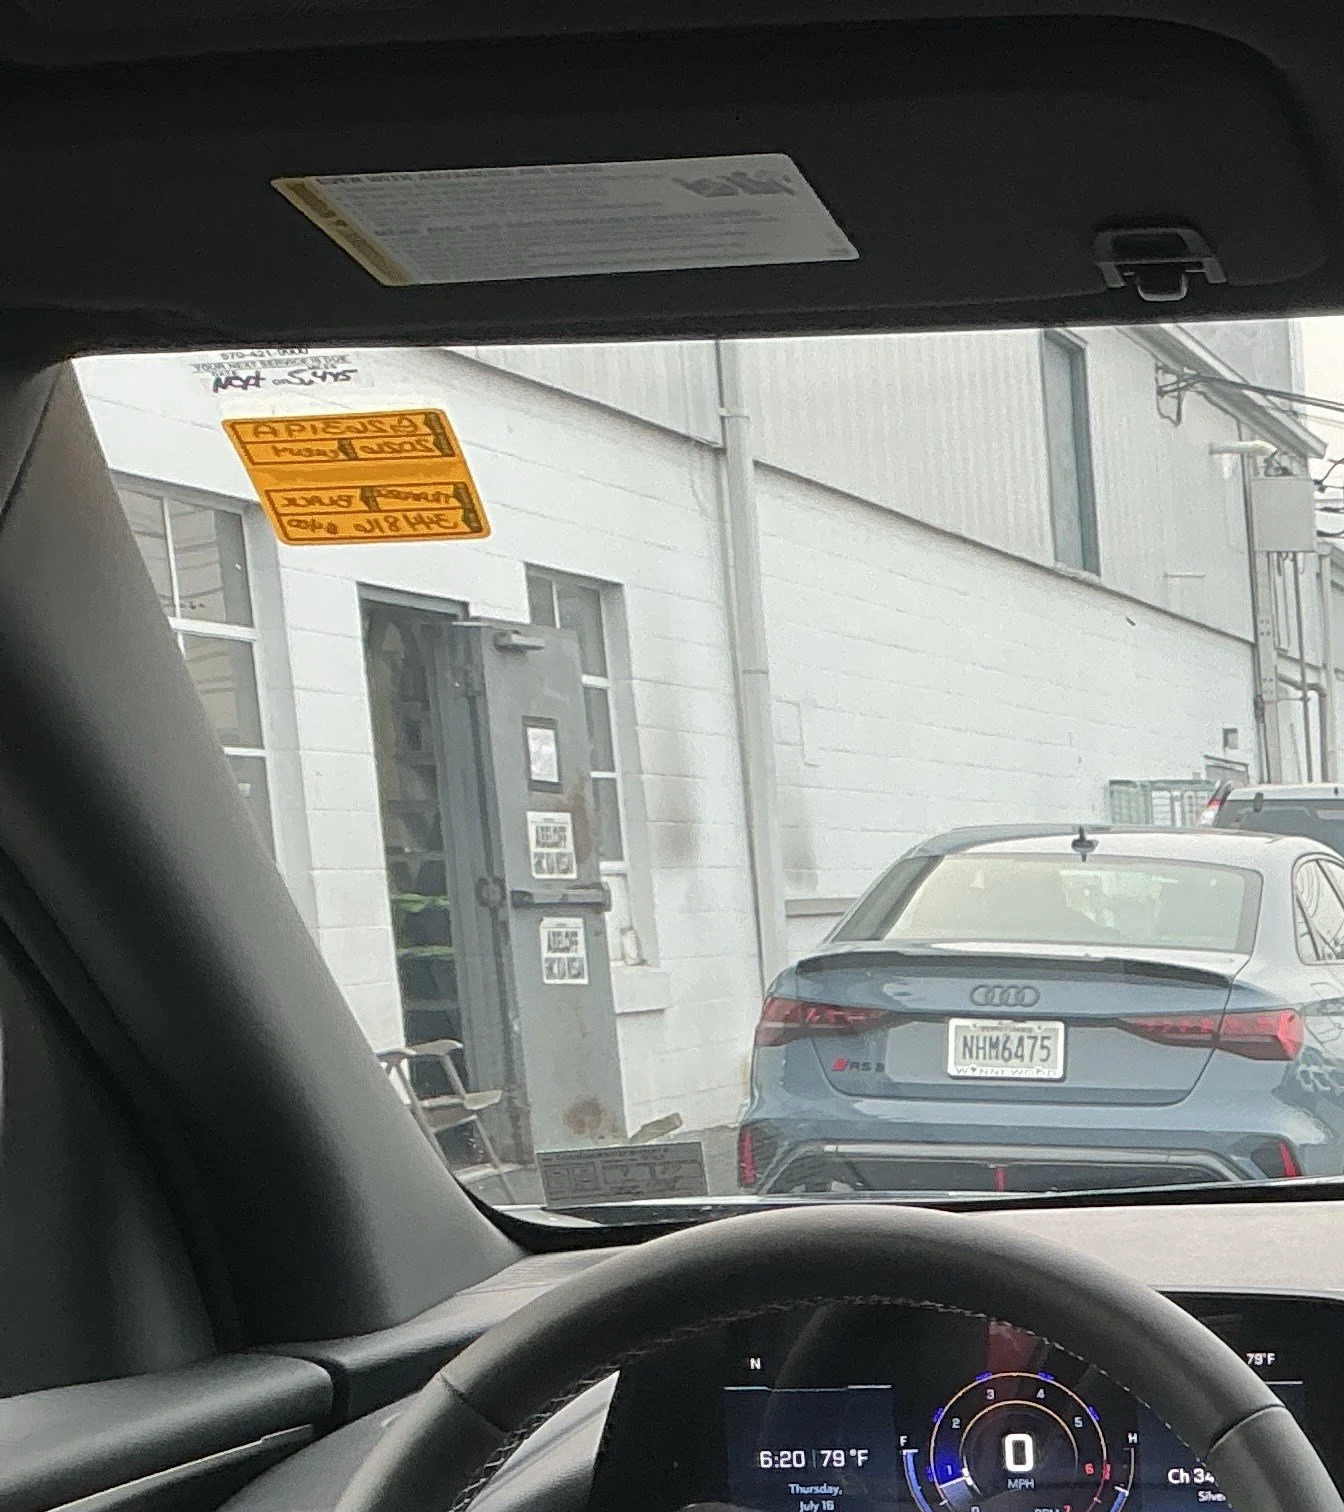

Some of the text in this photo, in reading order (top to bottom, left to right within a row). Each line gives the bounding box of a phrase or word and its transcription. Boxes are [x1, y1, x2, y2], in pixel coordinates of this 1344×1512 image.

[961, 1034, 1052, 1063] NHM6475
[750, 1358, 761, 1370] N
[986, 1388, 995, 1400] 3
[1036, 1388, 1046, 1400] 4
[951, 1418, 961, 1430] 2
[1074, 1416, 1083, 1428] 5
[900, 1436, 908, 1448] F
[1128, 1433, 1138, 1444] H
[1004, 1433, 1034, 1472] 0
[759, 1450, 805, 1468] 6:20
[1084, 1463, 1095, 1475] 6
[1167, 1468, 1190, 1484] Ch
[787, 1483, 843, 1497] Thursday,
[1007, 1478, 1035, 1490] MPH
[1198, 1490, 1227, 1502] Silve
